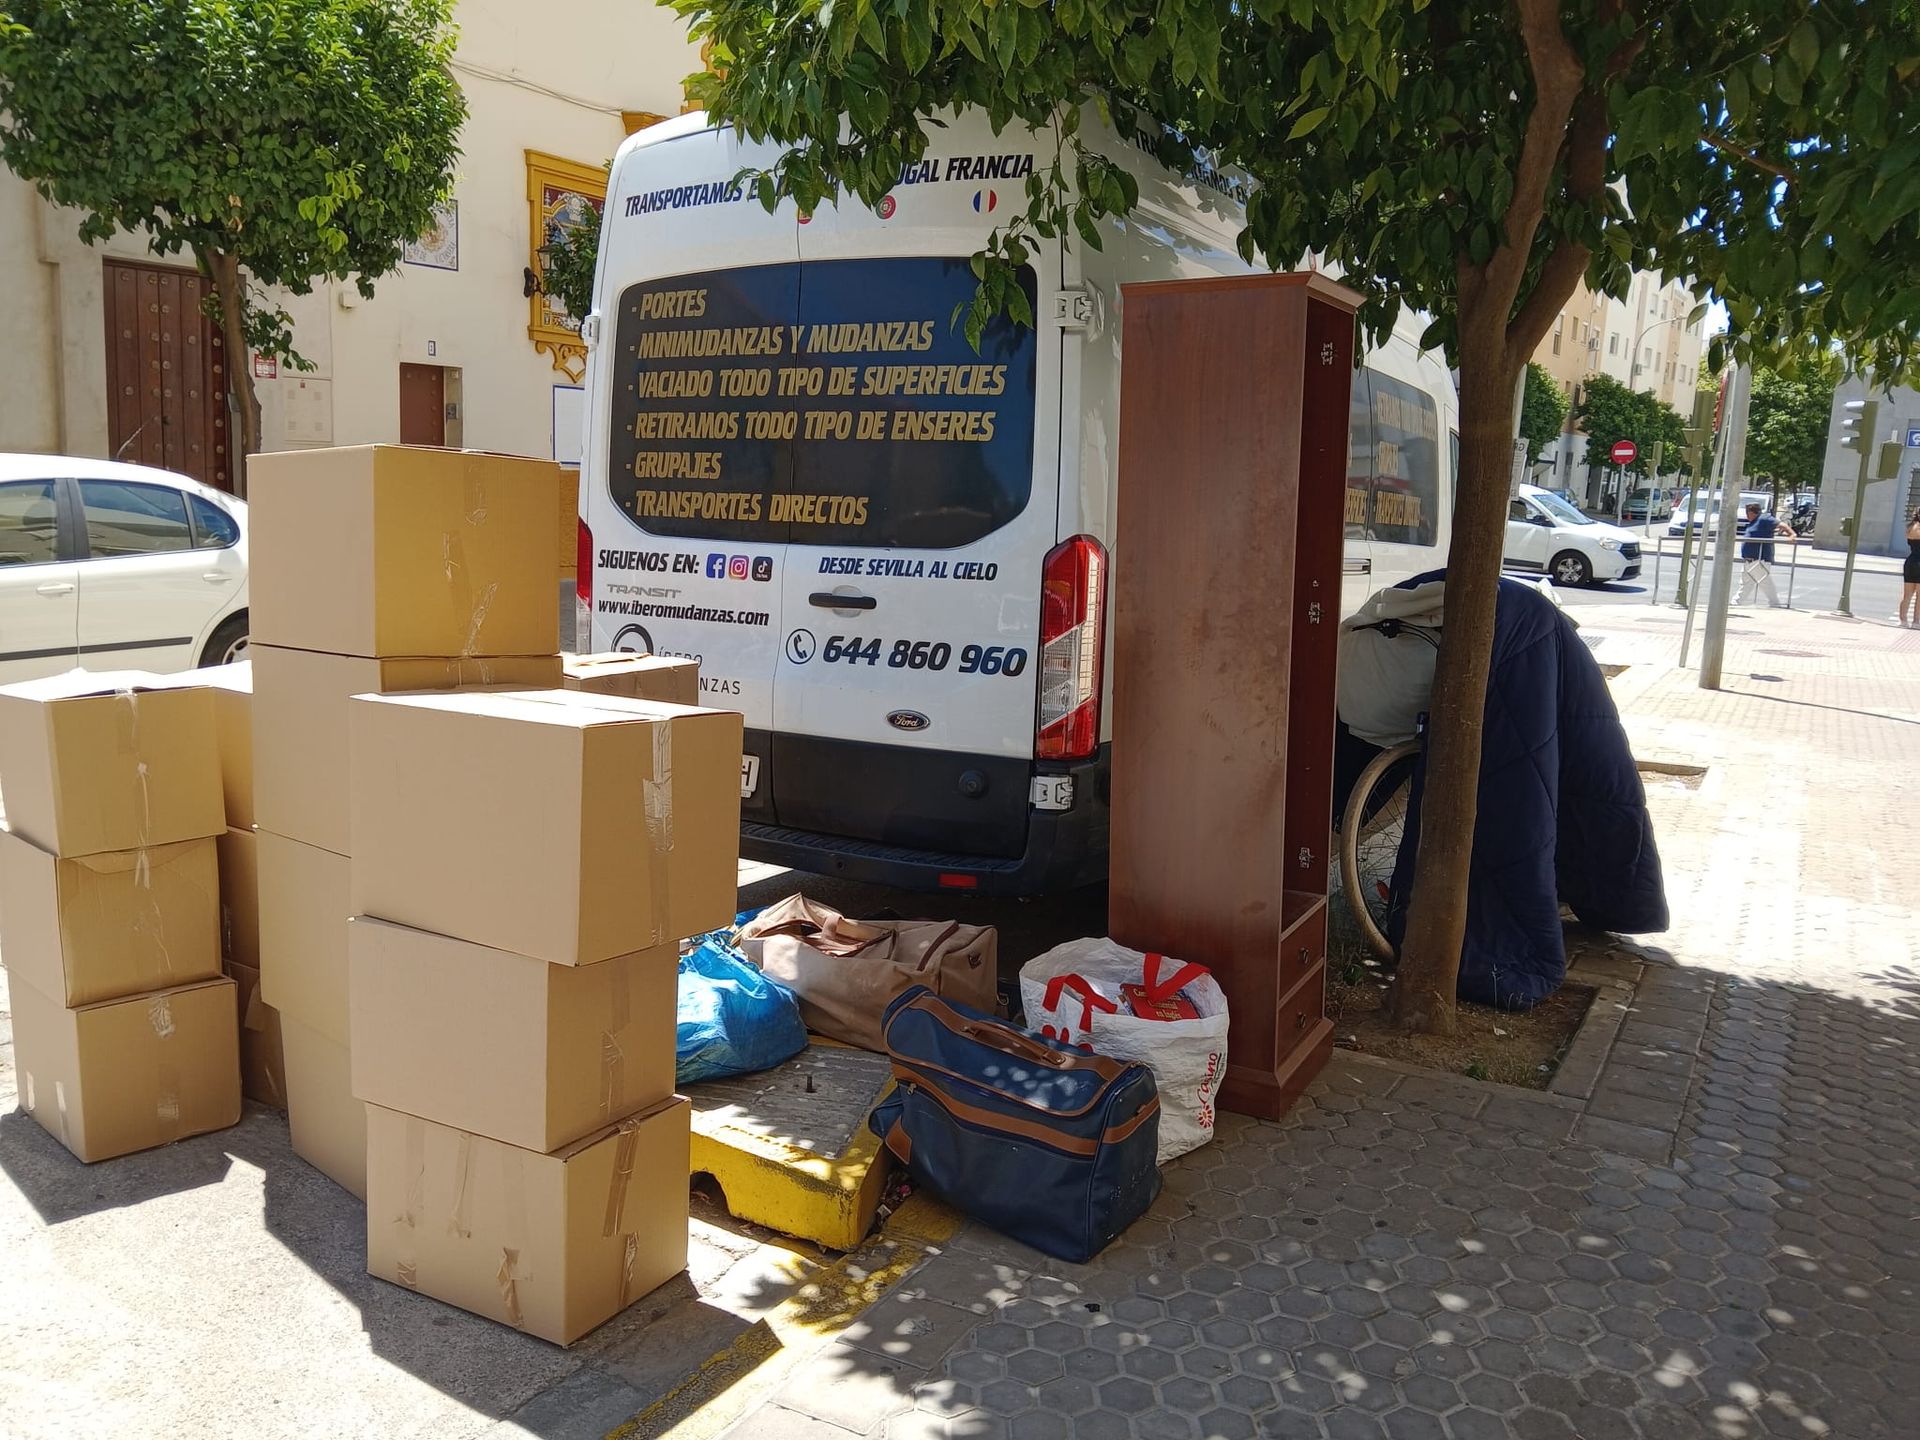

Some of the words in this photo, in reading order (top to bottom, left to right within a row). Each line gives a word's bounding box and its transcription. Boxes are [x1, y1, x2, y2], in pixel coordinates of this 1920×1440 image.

[624, 178, 743, 218] TRANSPORTAMOS
[945, 154, 1034, 182] FRANCIA
[639, 288, 707, 321] PORTES
[637, 325, 784, 360] MINIMUDANZAS
[789, 327, 802, 354] Y
[805, 320, 935, 353] MUDANZAS
[637, 369, 714, 399] VACIADO
[718, 367, 773, 397] TODO
[777, 366, 824, 397] TIPO
[827, 366, 857, 397] DE
[863, 364, 1008, 396] SUPERFICIES
[634, 411, 740, 440] RETIRAMOS
[744, 411, 799, 440] TODO
[803, 410, 853, 440] TIPO
[856, 411, 888, 441] DE
[890, 411, 997, 442] ENSERES
[634, 451, 723, 480] GRUPAJES
[635, 489, 763, 522] TRANSPORTES
[768, 493, 869, 526] DIRECTOS
[597, 549, 669, 573] SIGUENOS
[671, 552, 701, 575] EN:
[818, 556, 864, 575] DESDE
[868, 558, 923, 577] SEVILLA
[928, 559, 949, 580] AL
[953, 561, 998, 581] CIELO
[607, 583, 681, 598] TRANSIT
[598, 600, 769, 626] www.iberomudanzas.com
[822, 635, 881, 666] 644
[887, 639, 952, 672] 860
[957, 643, 1028, 678] 960
[700, 677, 741, 695] NZAS
[895, 713, 920, 727] Ford
[1197, 1053, 1218, 1104] Casino
